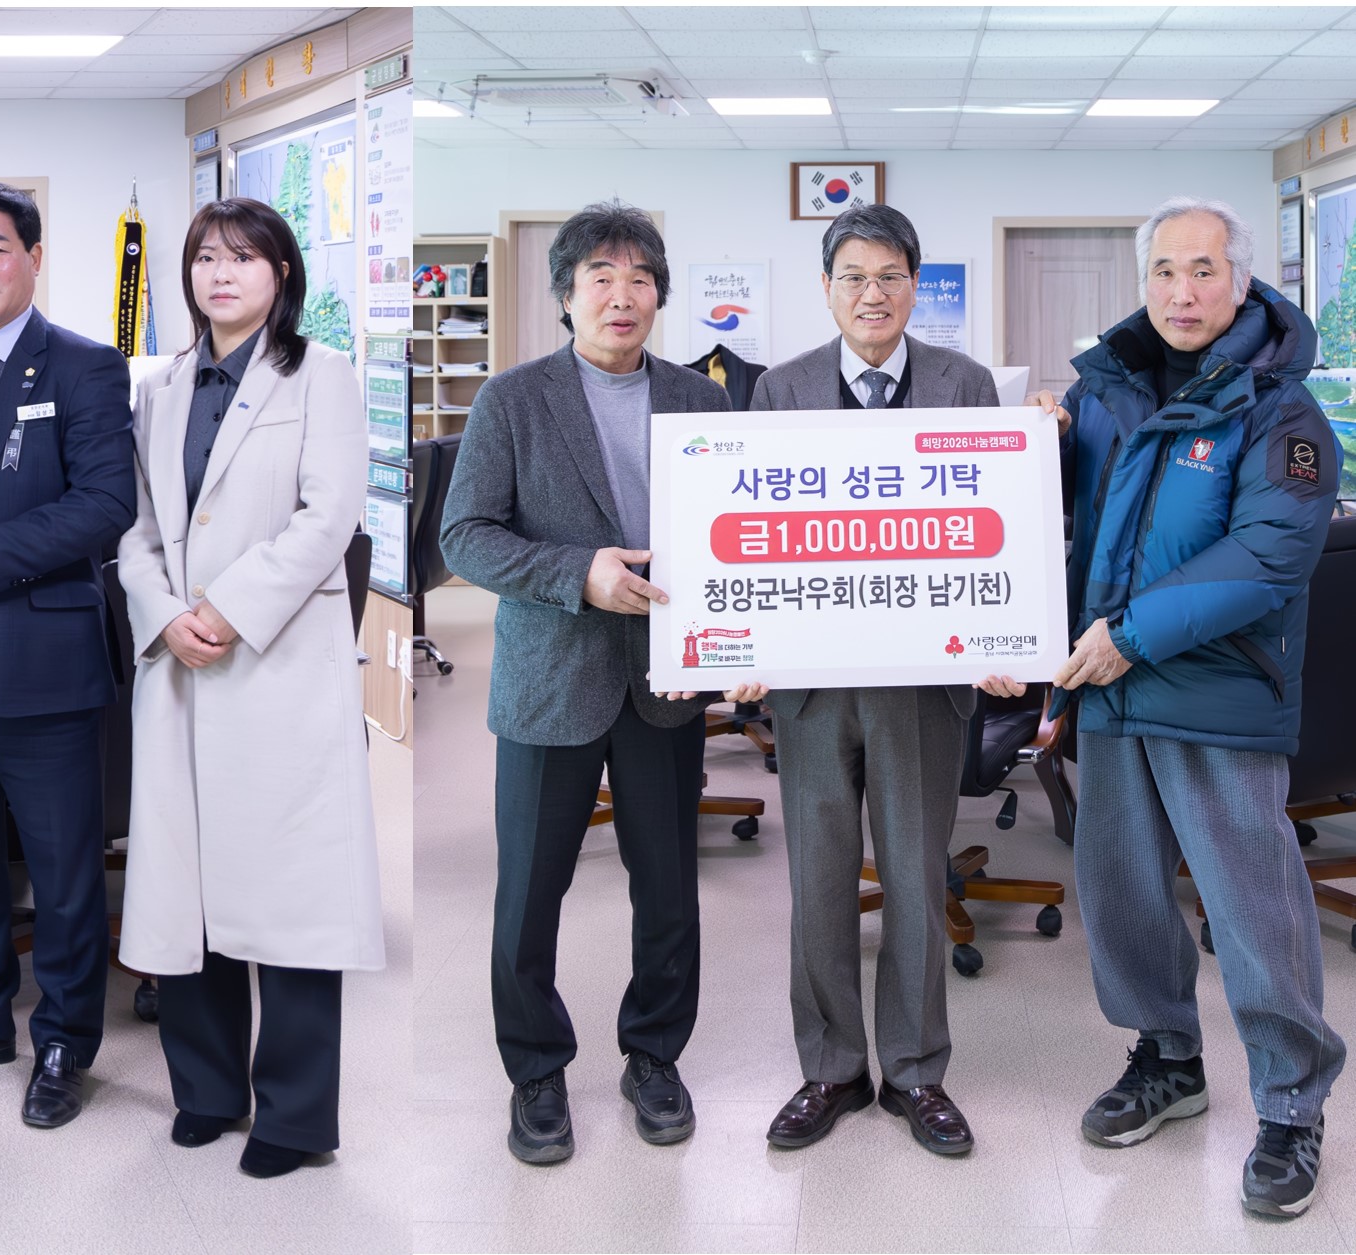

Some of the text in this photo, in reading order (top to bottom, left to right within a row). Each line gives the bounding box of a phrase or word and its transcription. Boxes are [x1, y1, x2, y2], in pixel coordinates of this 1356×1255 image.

[713, 441, 746, 453] 청양군
[921, 435, 1020, 450] 희망2026나눔캠페인
[1175, 457, 1215, 474] BLACK YAK
[731, 463, 981, 501] 사랑의 성금 기탁
[1290, 468, 1319, 481] PEAK
[739, 515, 975, 556] 금1,000,000원
[704, 571, 1012, 613] 청양군낙우회(회장 남기천)
[967, 635, 1037, 651] 사랑의열매
